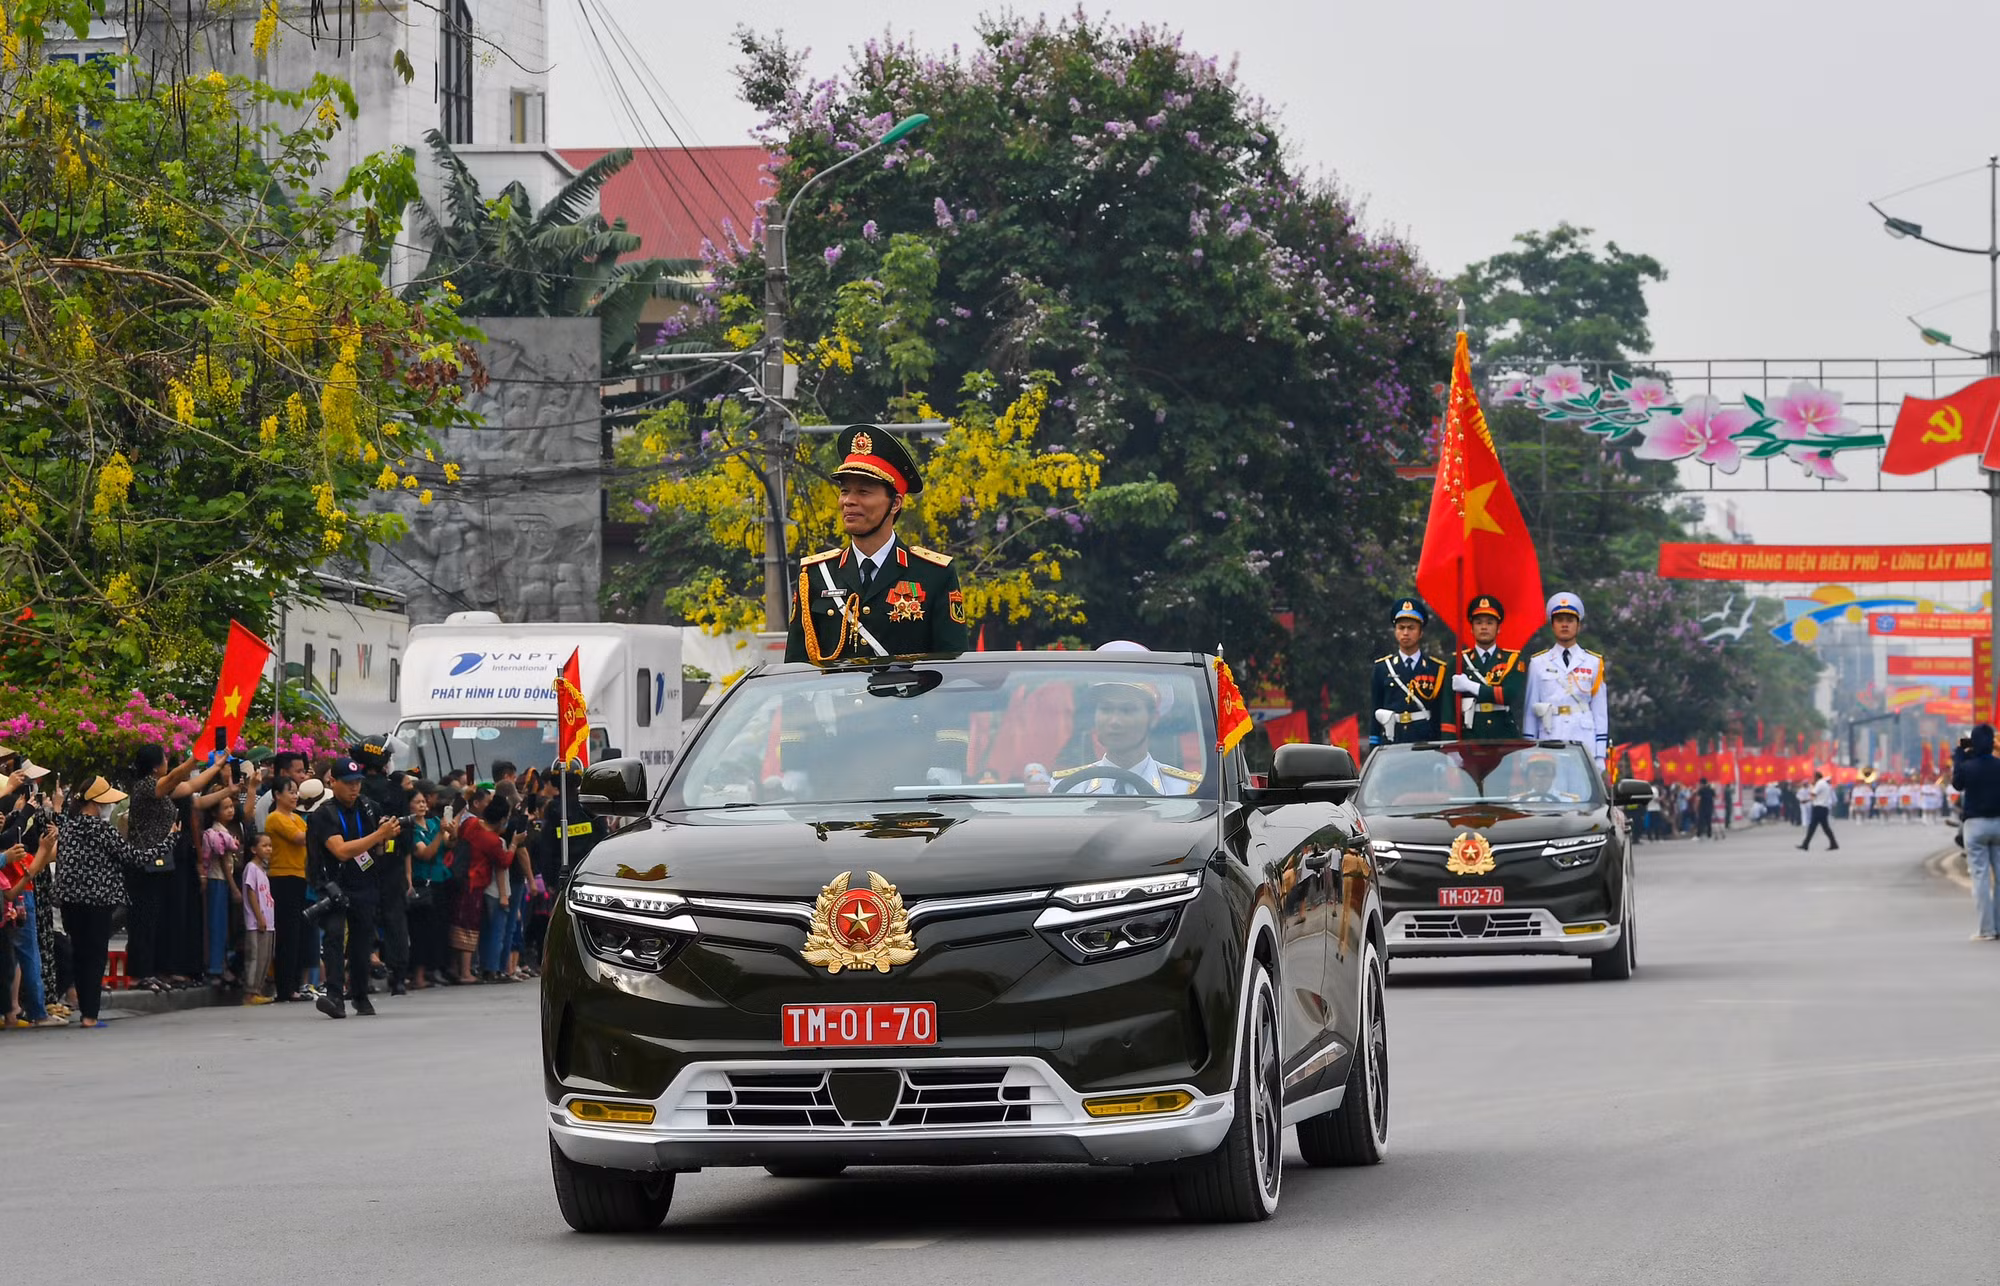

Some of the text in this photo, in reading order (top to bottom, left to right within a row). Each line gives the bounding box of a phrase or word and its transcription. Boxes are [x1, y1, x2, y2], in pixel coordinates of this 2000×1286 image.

[491, 653, 558, 661] VNPT
[492, 664, 548, 672] International
[431, 686, 462, 700] PHÁT
[465, 686, 495, 699] HÌNH
[524, 685, 557, 702] ĐỘNG
[461, 720, 517, 728] MITSUBISHI
[1441, 889, 1502, 905] TM-02-70
[787, 1007, 931, 1042] TM-01-70
